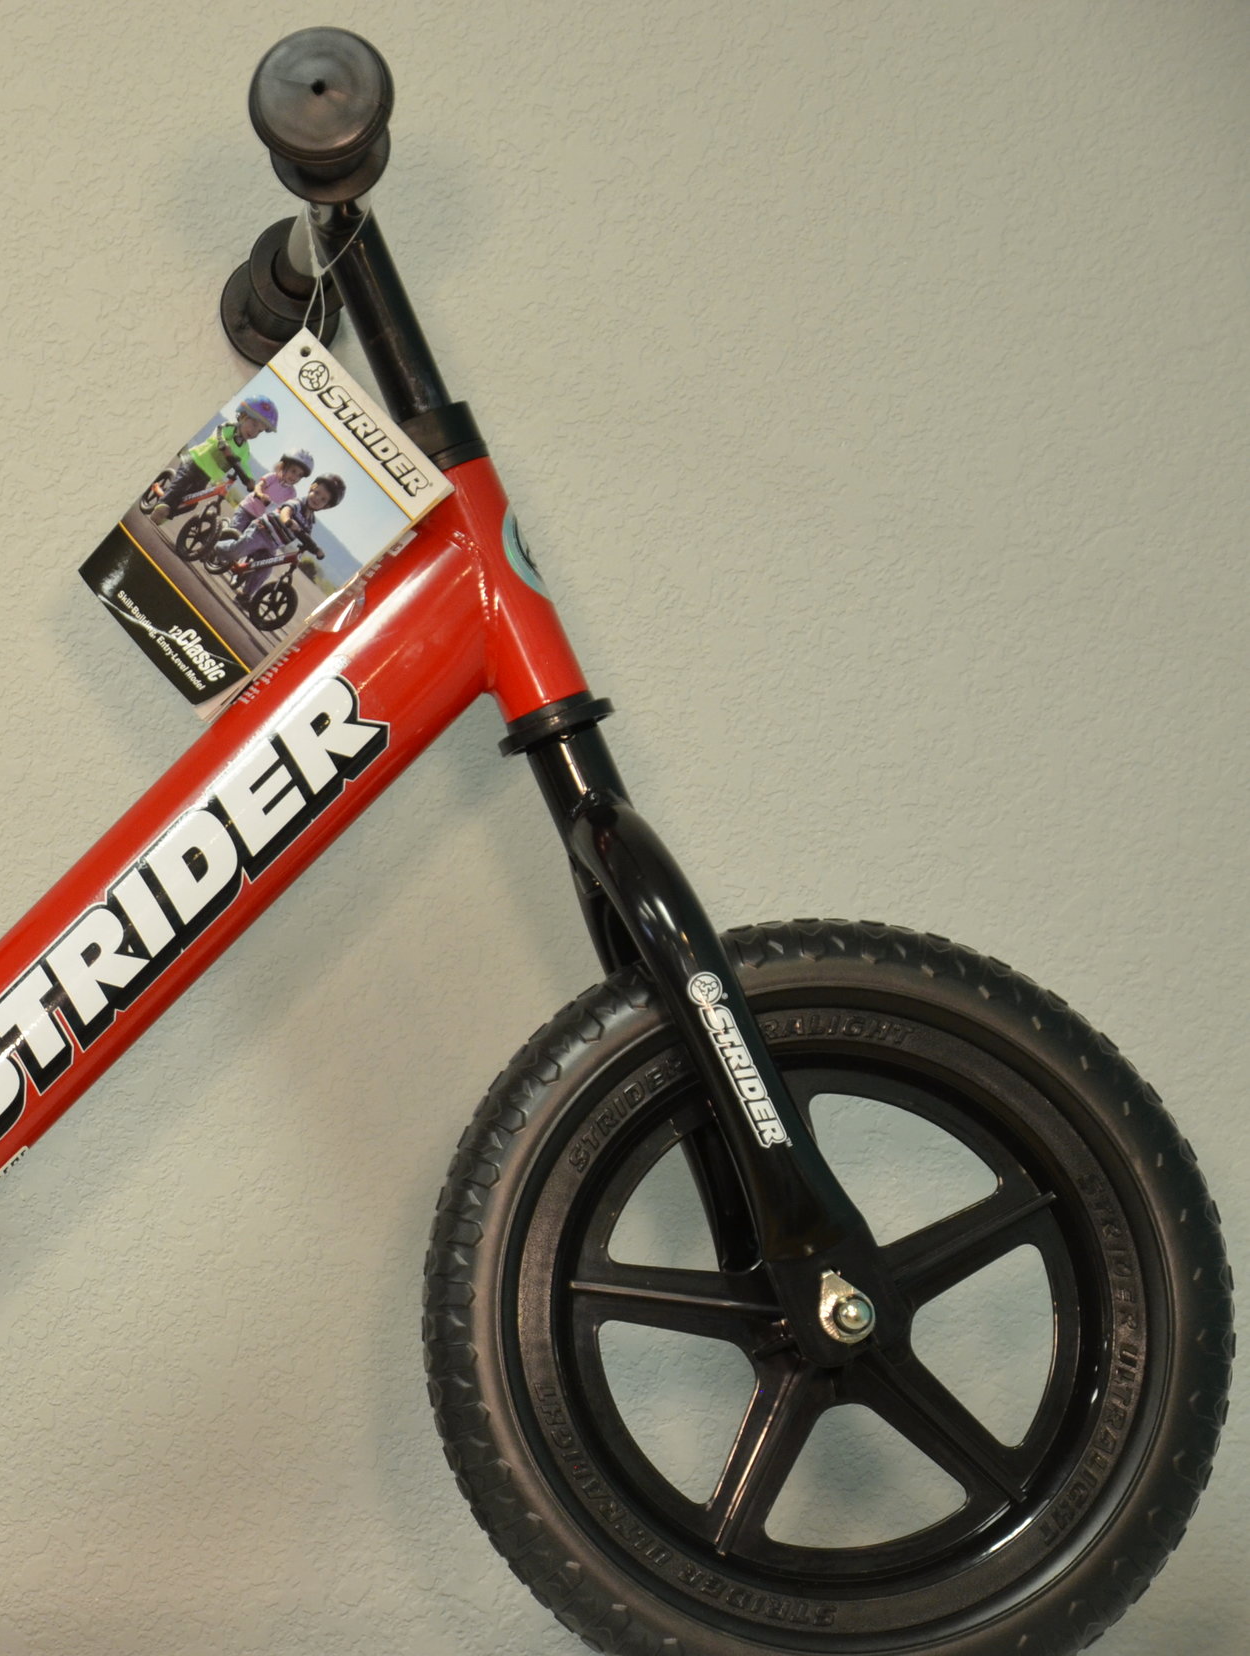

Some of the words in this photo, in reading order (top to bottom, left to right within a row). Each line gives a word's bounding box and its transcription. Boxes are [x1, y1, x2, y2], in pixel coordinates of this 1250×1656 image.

[318, 386, 430, 496] STRIDER
[155, 636, 188, 672] Entry-Level
[184, 668, 205, 691] Model
[699, 1004, 787, 1148] STRIDER
[760, 1013, 915, 1047] RALIGHT
[1083, 1169, 1137, 1328] STRIDER
[536, 1382, 673, 1571] ULTRALIGHT
[1036, 1344, 1141, 1545] ULTRALIGHT
[676, 1564, 836, 1626] STRIDER
